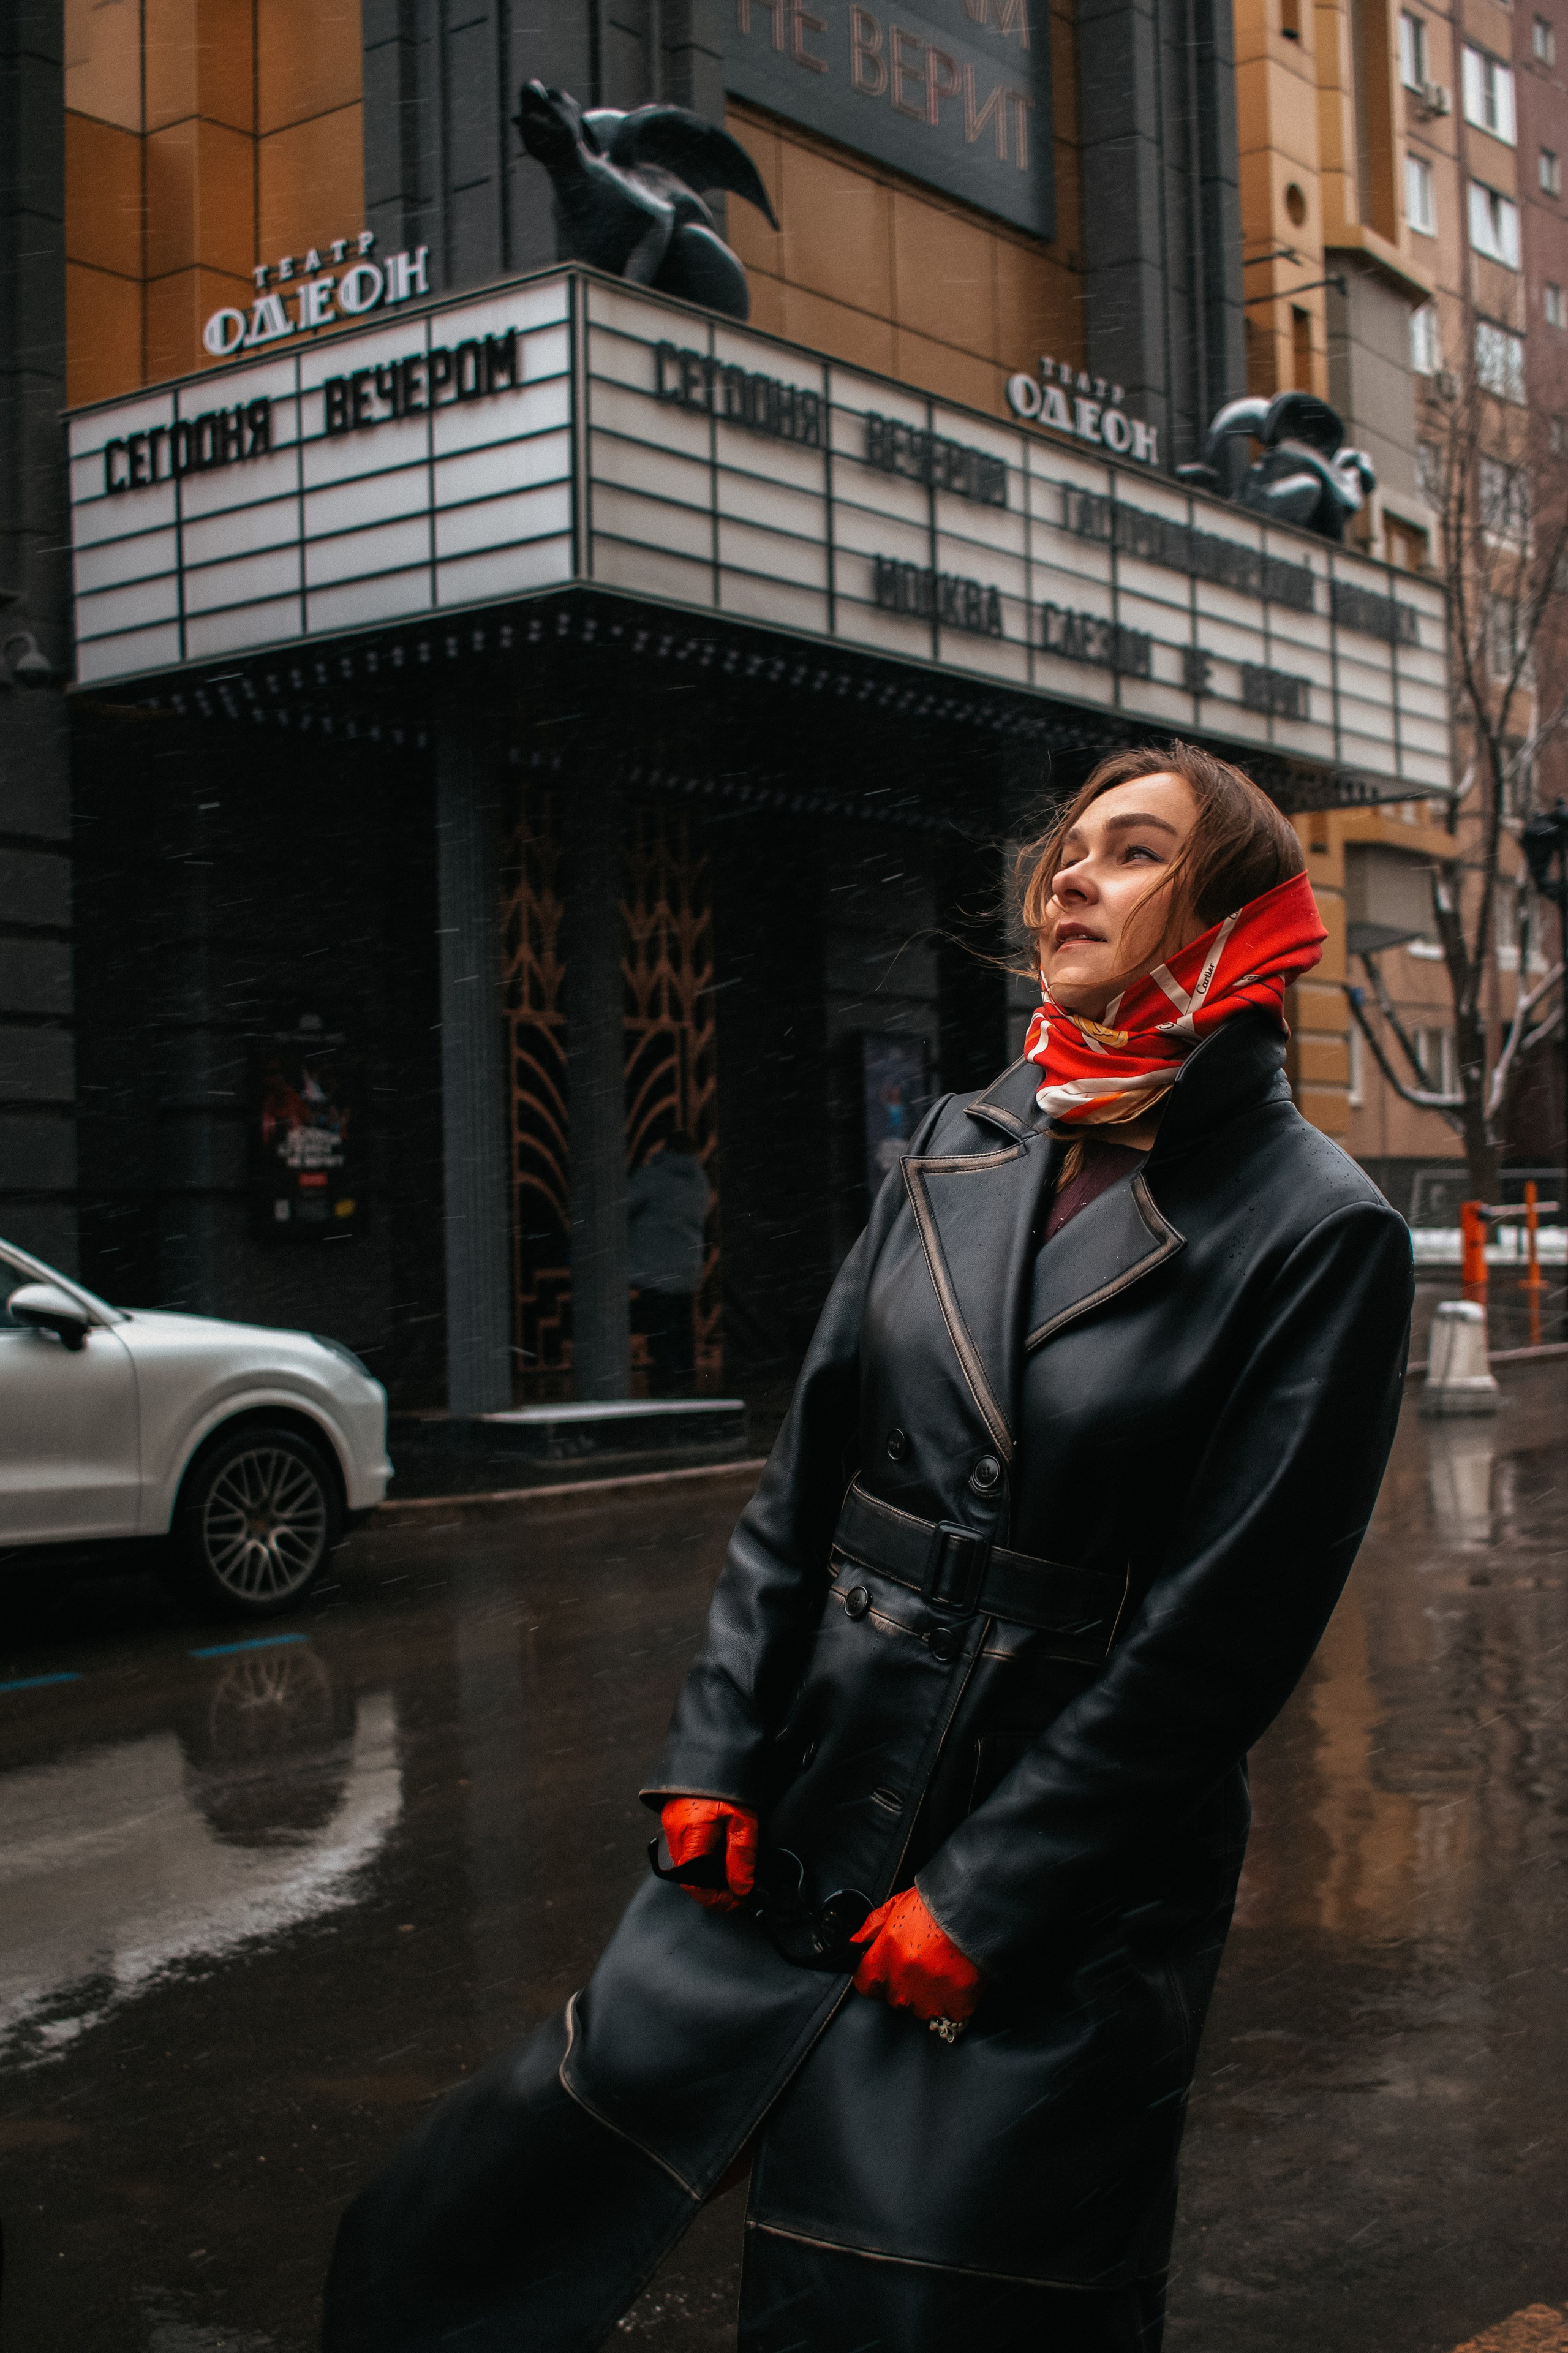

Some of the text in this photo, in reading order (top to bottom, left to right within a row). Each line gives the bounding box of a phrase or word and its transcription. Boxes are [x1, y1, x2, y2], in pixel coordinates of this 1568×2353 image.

[849, 3, 1035, 170] ВЕРИТ
[203, 246, 429, 357] ОДЕОН
[253, 230, 374, 288] ТЕАТР
[104, 326, 518, 494] СЕГОДНЯ ВЕЧЕРОМ
[655, 339, 829, 453] СЕГОДНЯ
[1007, 372, 1159, 466] ОДЕОН
[1039, 354, 1125, 406] ТЕАТР
[1196, 962, 1215, 994] Cartier
